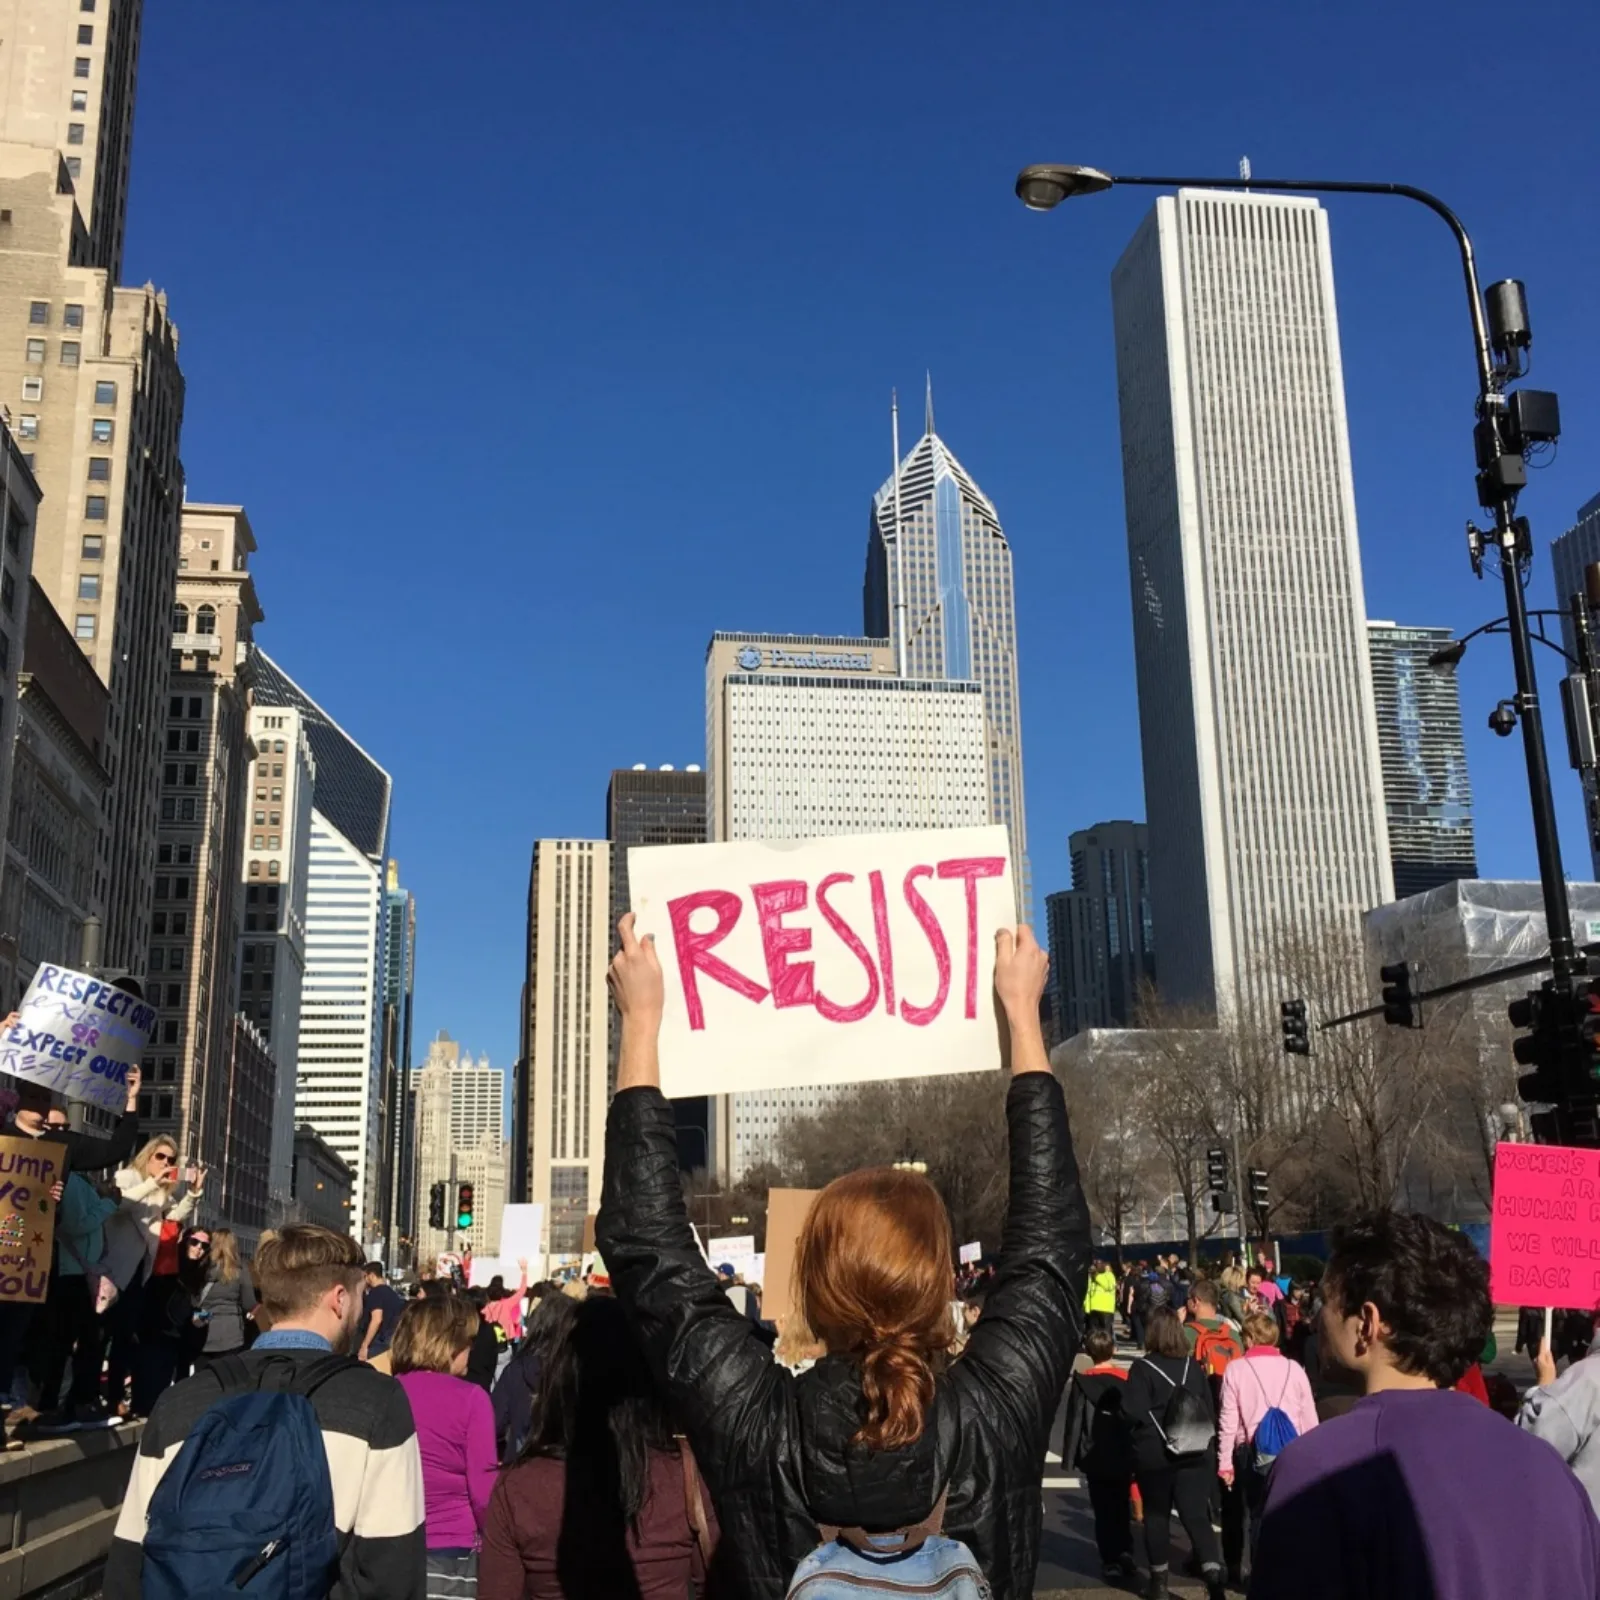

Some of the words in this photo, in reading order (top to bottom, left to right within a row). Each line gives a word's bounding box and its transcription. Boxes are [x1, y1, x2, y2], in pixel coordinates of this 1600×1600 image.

[771, 649, 872, 671] Prudential
[667, 856, 1006, 1031] RESIST
[37, 965, 133, 1017] RESPECT
[131, 1003, 156, 1035] OUR
[71, 1023, 100, 1048] OR
[8, 1023, 88, 1064] EXPECT
[89, 1055, 130, 1086] OUR
[1498, 1150, 1586, 1176] WOMEN'S
[1561, 1178, 1600, 1200] AR
[1498, 1196, 1577, 1221] HUMAN
[1507, 1232, 1541, 1254] WE
[1551, 1236, 1600, 1260] WILL
[1509, 1264, 1571, 1289] BACK
